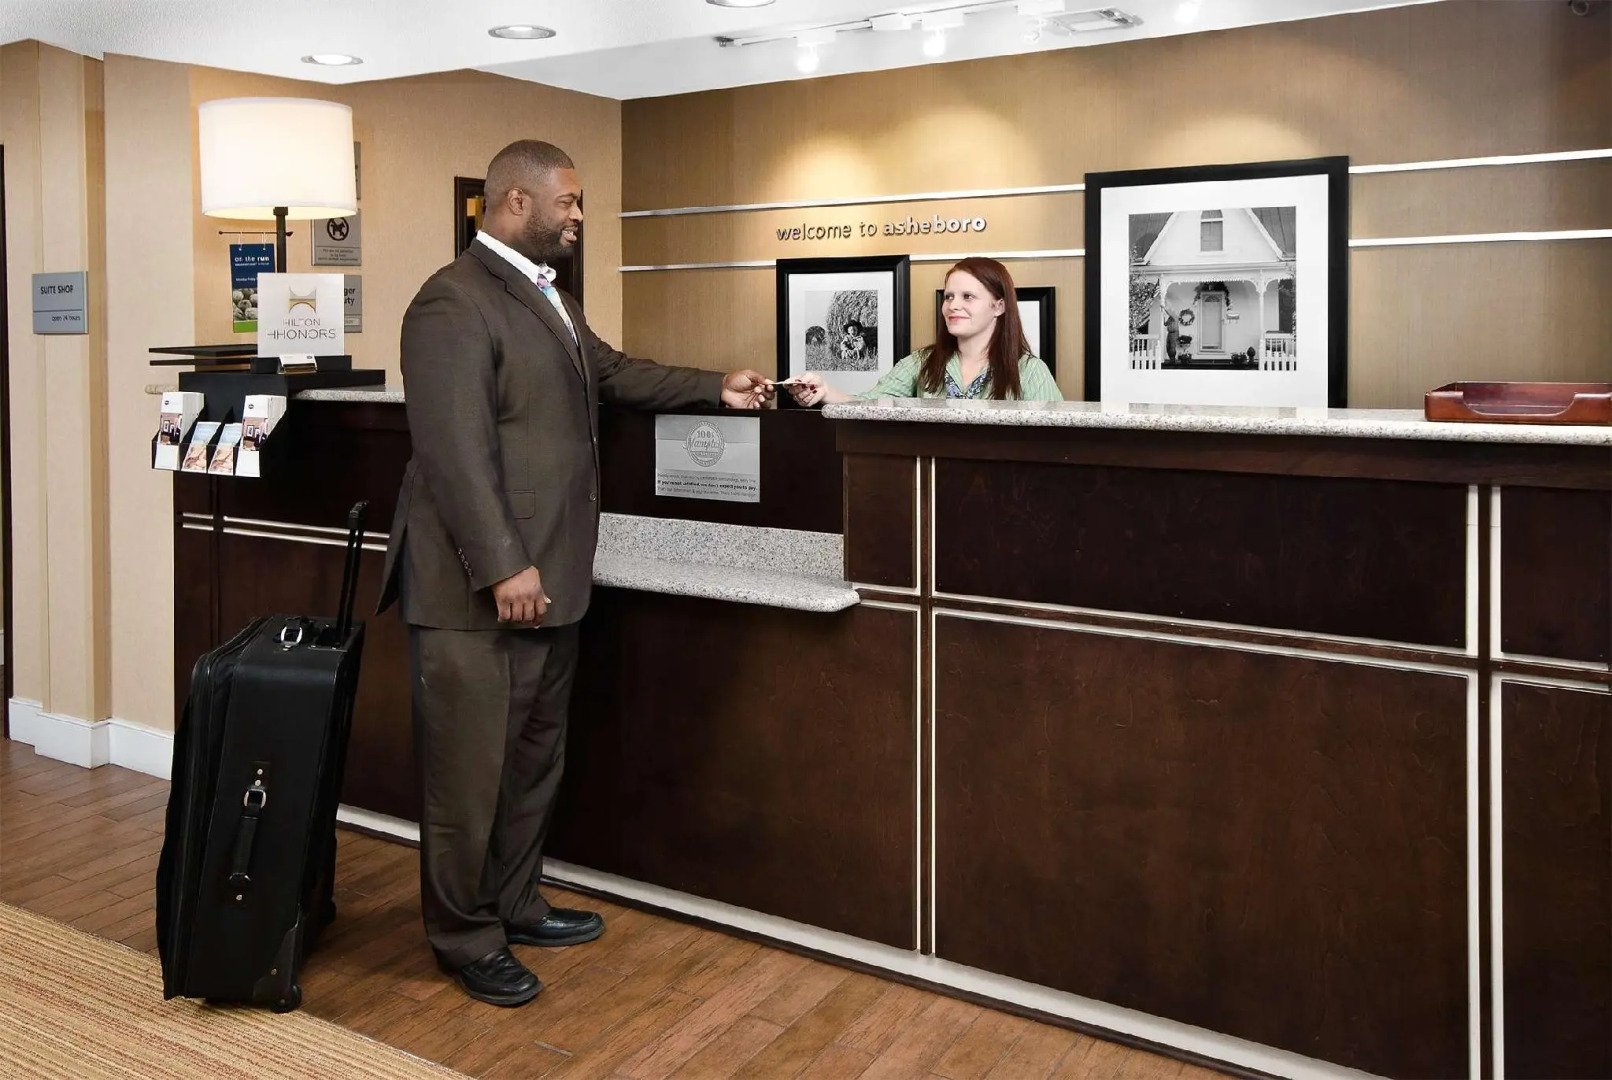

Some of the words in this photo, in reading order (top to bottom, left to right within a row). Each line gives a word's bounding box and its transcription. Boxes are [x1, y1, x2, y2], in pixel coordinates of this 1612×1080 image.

[776, 223, 852, 241] welcome
[859, 221, 878, 237] to
[882, 214, 988, 236] asheboro
[41, 286, 56, 295] SUITE
[57, 284, 74, 294] SHOP
[283, 318, 321, 327] HILTON
[267, 328, 336, 340] HHONORS
